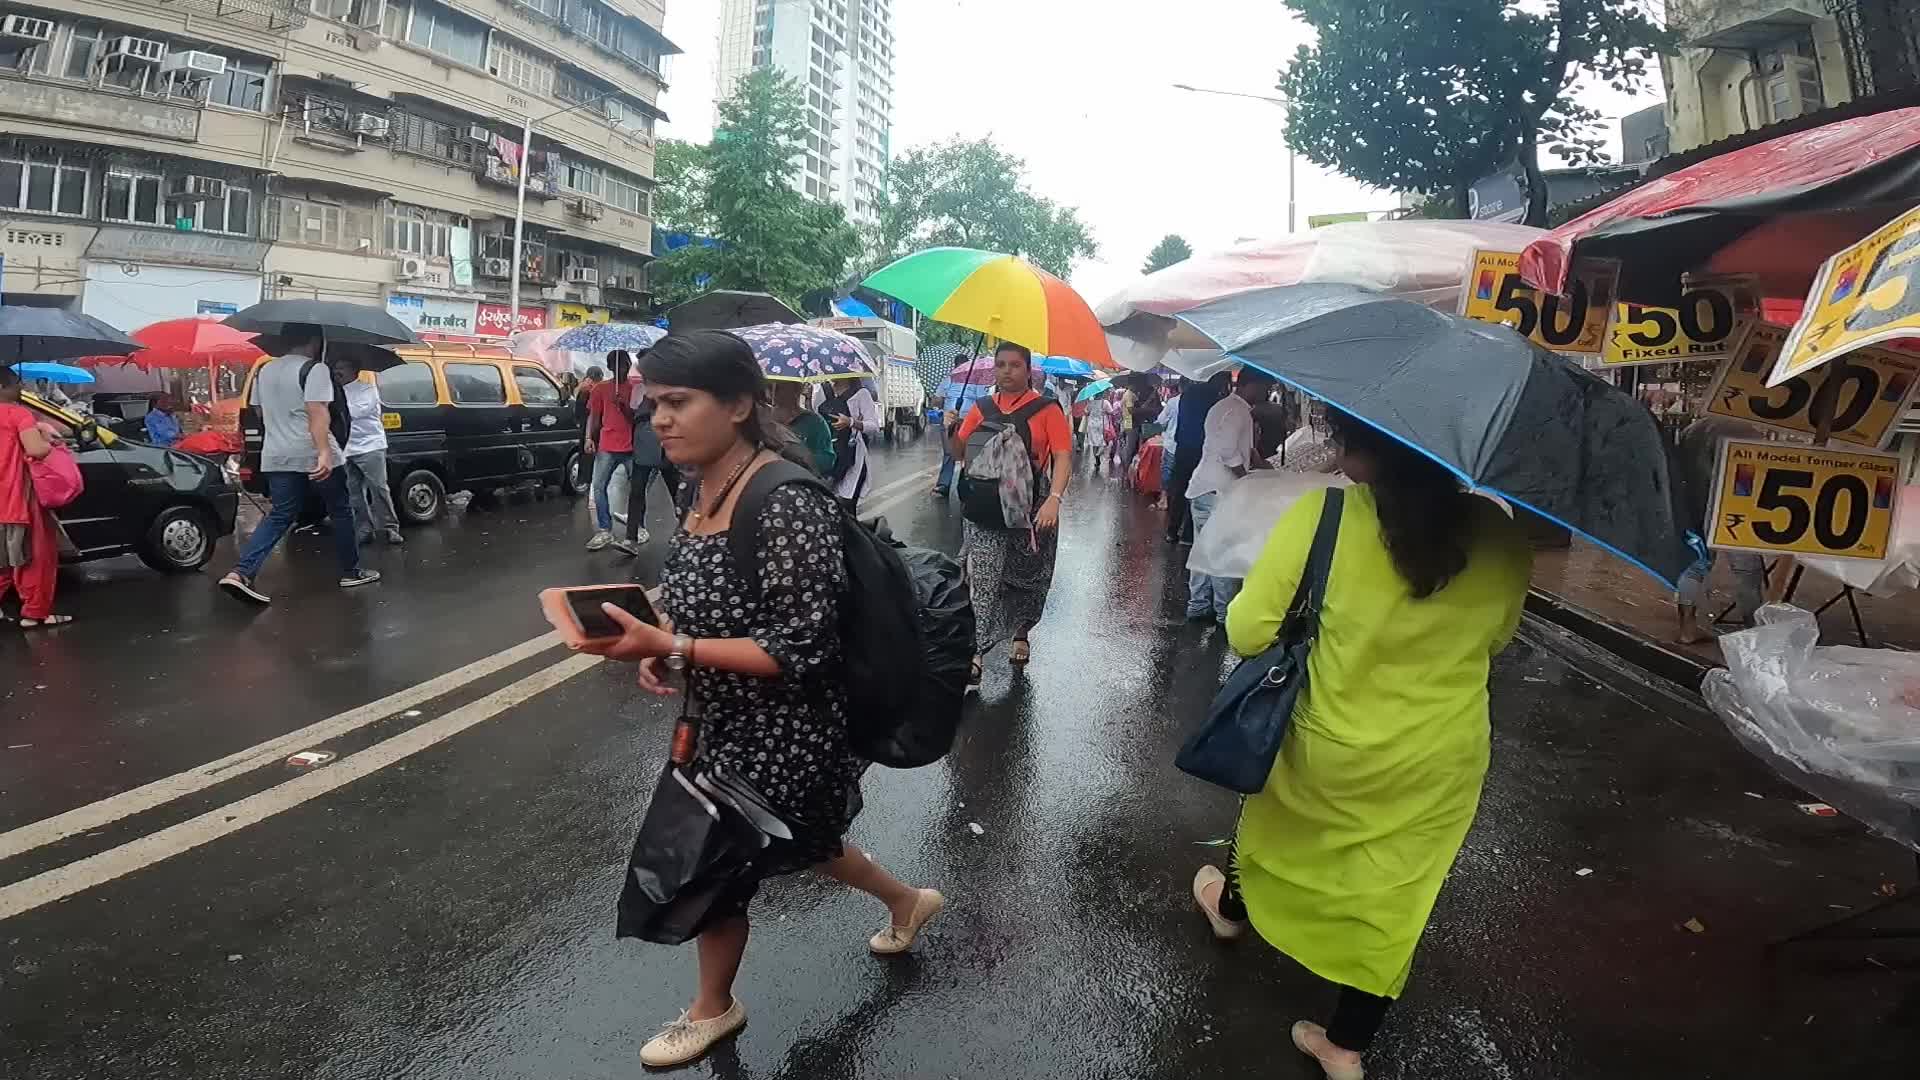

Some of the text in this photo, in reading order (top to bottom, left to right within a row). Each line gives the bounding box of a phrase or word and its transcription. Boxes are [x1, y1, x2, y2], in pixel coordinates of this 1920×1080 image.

[1479, 256, 1495, 266] All
[1471, 273, 1588, 346] 50
[1622, 342, 1727, 359] Fixed Rat
[1733, 449, 1752, 460] All
[1757, 451, 1801, 465] Model
